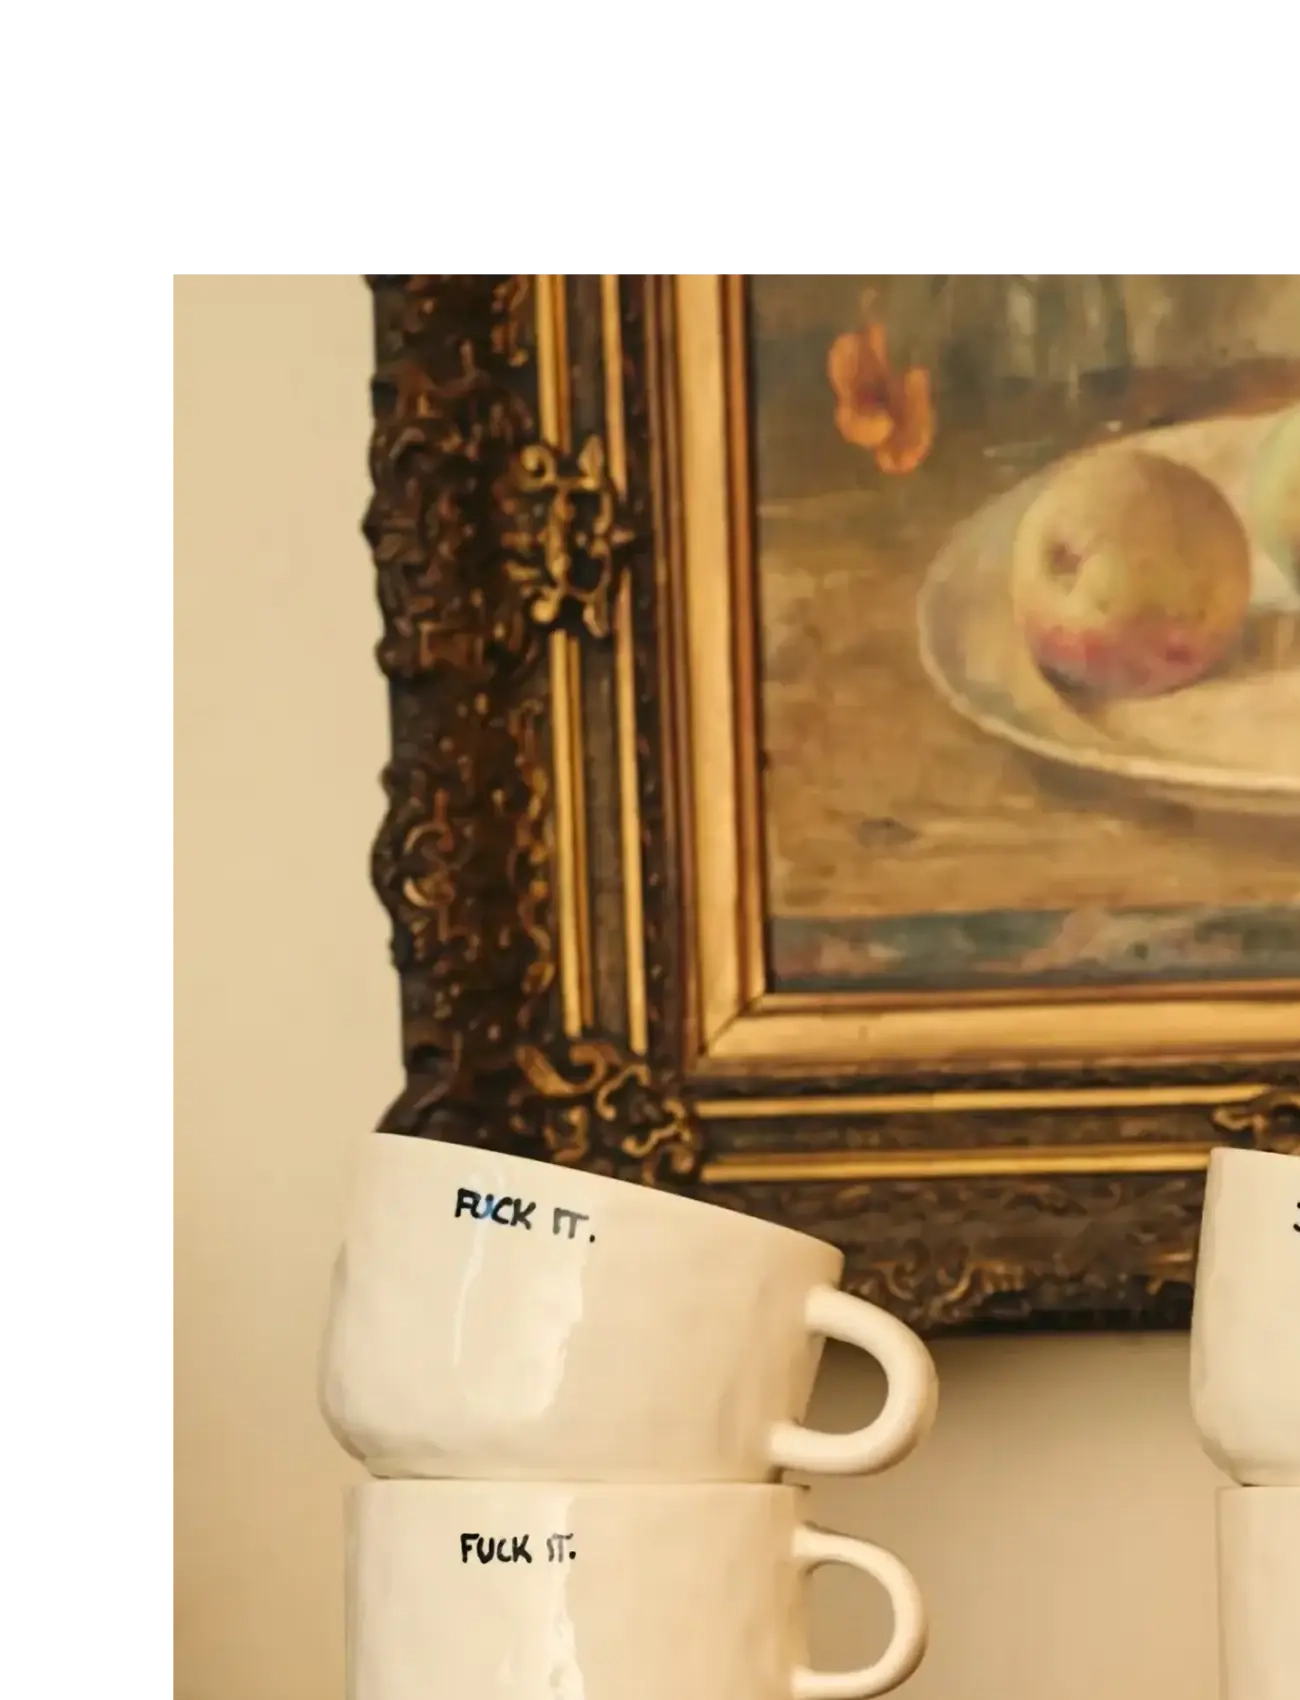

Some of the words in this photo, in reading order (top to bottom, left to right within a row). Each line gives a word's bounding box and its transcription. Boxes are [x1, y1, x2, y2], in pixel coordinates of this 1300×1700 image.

[454, 1187, 536, 1230] FUCK
[553, 1207, 596, 1244] IT.
[460, 1532, 533, 1564] FUCK
[546, 1532, 577, 1563] IT.
